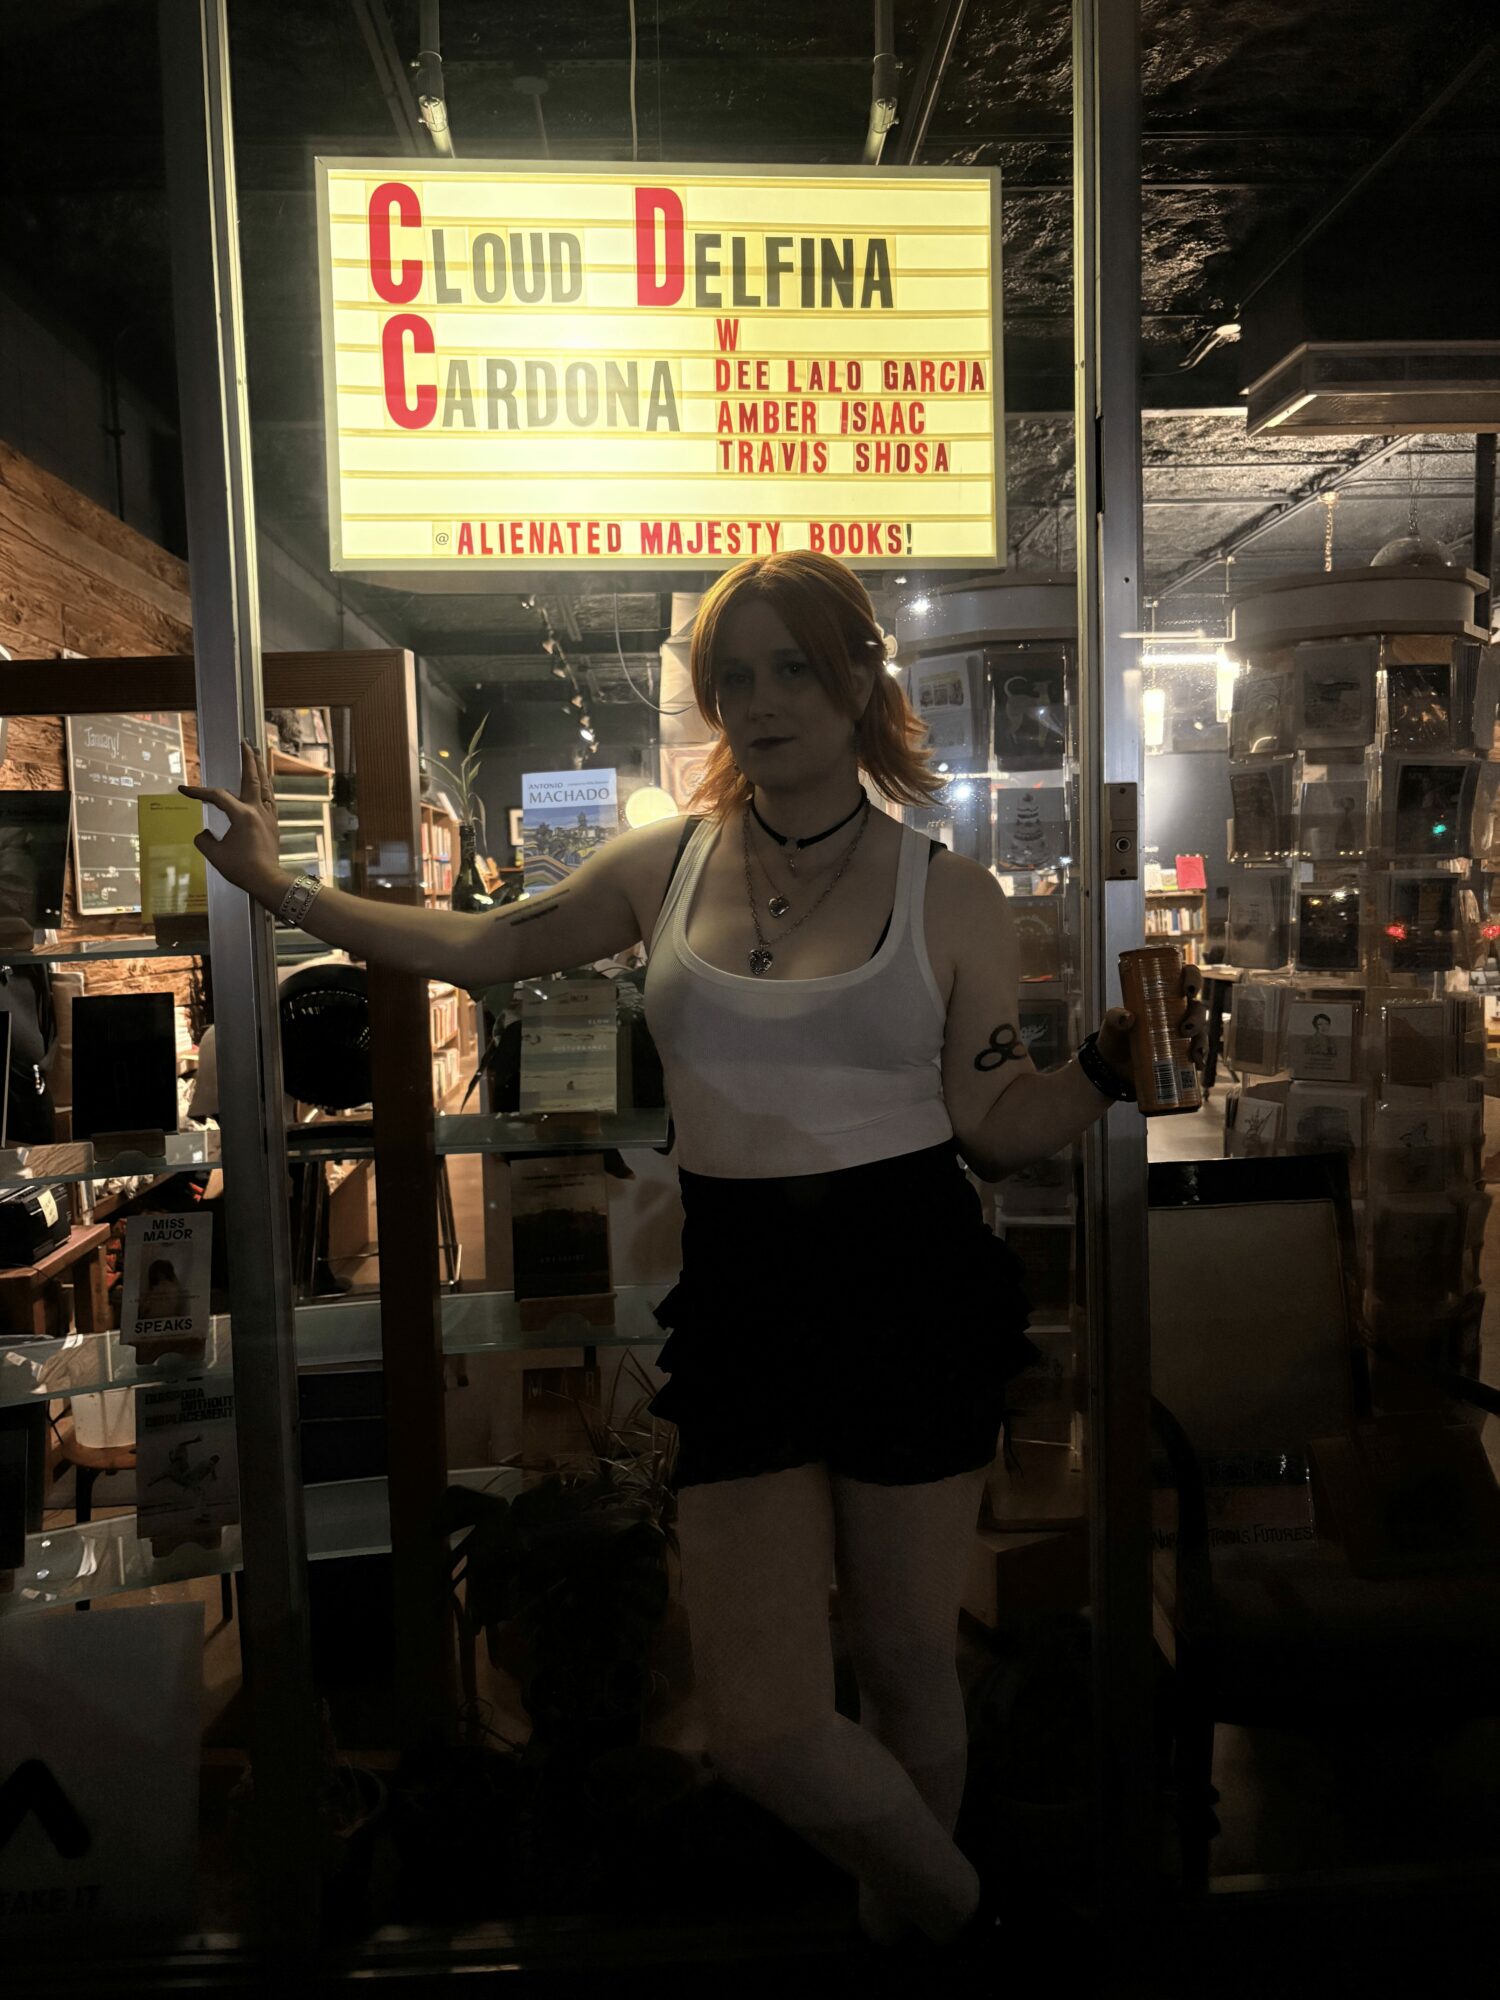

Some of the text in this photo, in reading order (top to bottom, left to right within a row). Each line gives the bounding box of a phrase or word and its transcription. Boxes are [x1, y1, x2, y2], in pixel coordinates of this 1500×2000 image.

[368, 182, 894, 309] CLOUD DELFINA
[716, 318, 740, 352] W
[382, 314, 680, 431] CARDONA
[715, 358, 986, 394] DEE LALO GARCIA
[718, 400, 925, 435] AMBER ISAAC
[719, 440, 949, 475] TRAVIS SHOSA
[458, 522, 621, 556] ALIENATED
[640, 521, 781, 556] MAJESTY
[809, 522, 913, 556] BOOKS!
[528, 782, 564, 790] ANTONIO
[529, 787, 610, 804] MACHADO
[143, 1228, 193, 1242] MAJOR
[152, 1218, 185, 1230] MISS
[135, 1318, 193, 1334] SPEAKS
